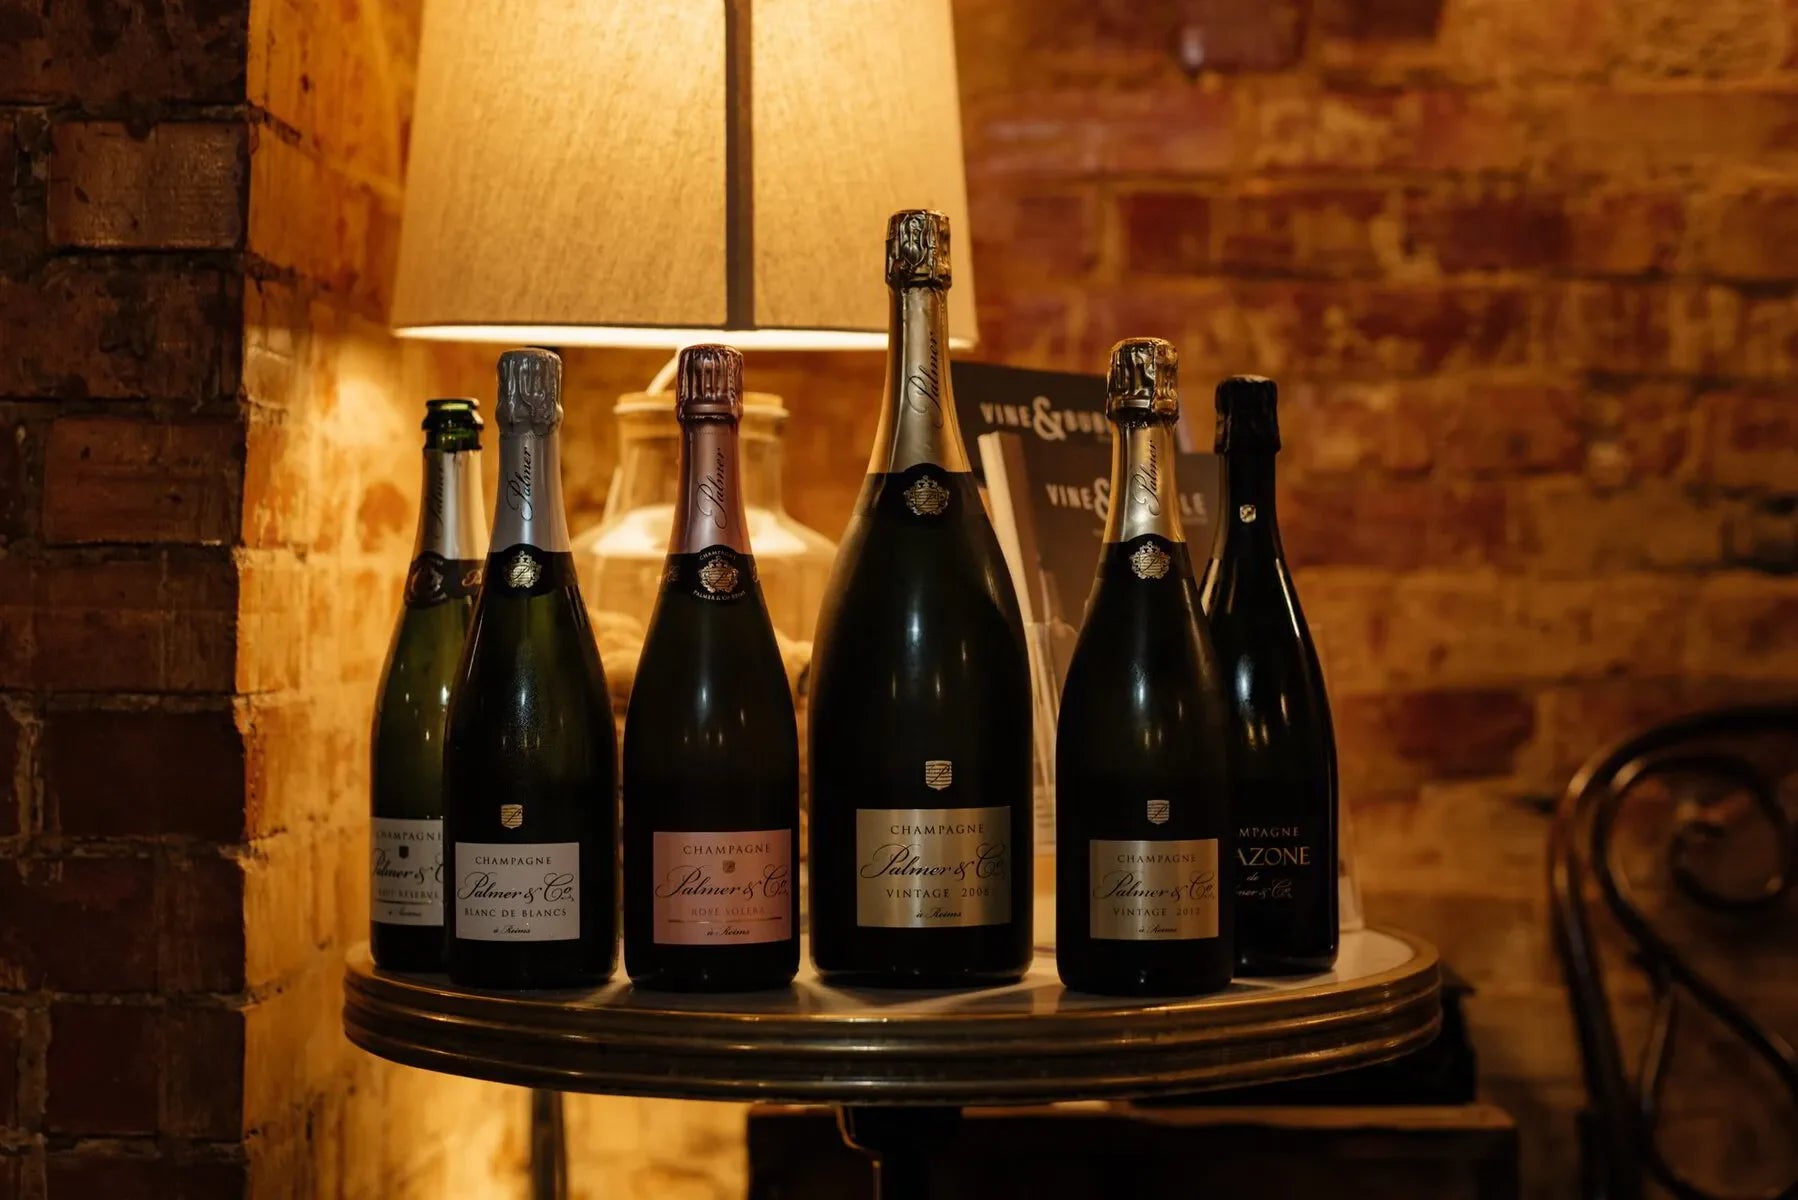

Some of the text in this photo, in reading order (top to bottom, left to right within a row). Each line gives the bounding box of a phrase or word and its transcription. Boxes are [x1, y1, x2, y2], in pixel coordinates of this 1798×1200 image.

[507, 446, 533, 522] Palmer
[1131, 439, 1161, 517] Palmer
[696, 447, 728, 530] Palmer
[891, 823, 985, 835] CHAMPAGNE
[1239, 826, 1300, 838] MPAGNE
[683, 843, 771, 855] CHAMPAGNE
[1236, 846, 1312, 866] AZONE
[475, 855, 552, 865] CHAMPAGNE
[859, 843, 952, 879] Palmer
[953, 860, 975, 881] &
[1117, 853, 1197, 864] CHAMPAGNE
[457, 871, 523, 900] Palmer
[523, 887, 543, 903] &
[655, 865, 741, 899] Palmer
[742, 880, 762, 901] &
[1093, 869, 1168, 900] Palmer
[1170, 884, 1188, 902] &
[886, 888, 951, 898] VINTAGE
[464, 908, 567, 918] BLANC DE BLANCS
[1112, 907, 1168, 917] VINTAGE
